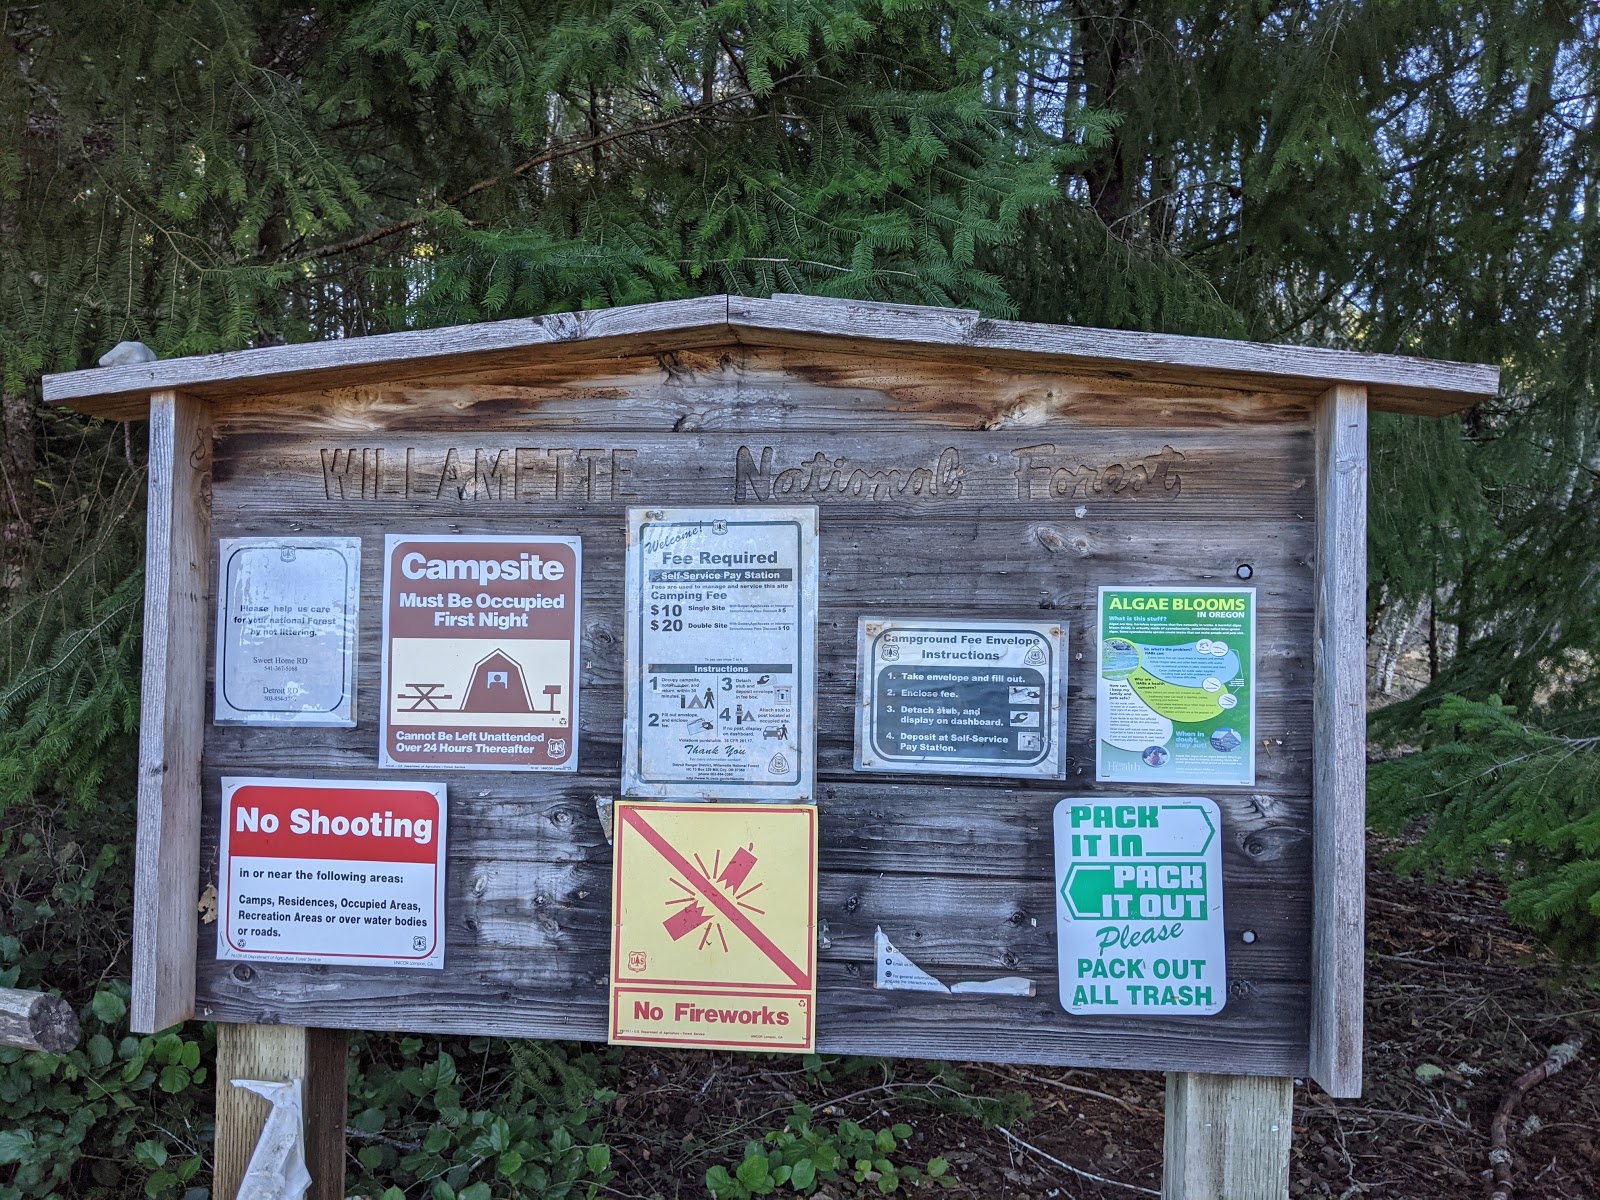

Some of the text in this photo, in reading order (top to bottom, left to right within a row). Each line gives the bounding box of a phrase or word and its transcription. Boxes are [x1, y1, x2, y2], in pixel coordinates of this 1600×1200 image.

[320, 444, 1185, 501] WILLAMETTE National Forest
[644, 521, 703, 554] Welcome!
[662, 551, 778, 566] Fee Required
[401, 552, 565, 586] Campsite
[661, 572, 719, 580] Self-Service
[723, 572, 742, 581] Pay
[400, 593, 565, 611] Must Be Occupied
[651, 591, 727, 602] Camping Fee
[240, 604, 268, 612] Please
[274, 605, 292, 613] help
[688, 605, 710, 613] Single
[1109, 597, 1245, 611] ALGAE BLOOMS
[234, 616, 246, 624] for
[248, 617, 267, 625] your
[307, 617, 336, 625] Forest
[434, 612, 528, 630] First Night
[280, 628, 317, 637] littering.
[883, 634, 1040, 647] Campground Fee Envelope
[253, 656, 273, 664] Sweet
[922, 650, 1000, 661] Instructions
[694, 665, 749, 673] Instructions
[649, 676, 659, 691] 1
[721, 676, 733, 691] 3
[901, 673, 924, 681] Take
[927, 674, 969, 684] envelope
[992, 675, 1004, 683] fill
[263, 686, 285, 694] Detroit
[887, 689, 959, 698] 2. Enclose fee.
[719, 707, 731, 721] 4
[901, 706, 934, 714] Detach
[936, 707, 960, 716] stub,
[962, 708, 980, 716] and
[648, 713, 659, 727] 2
[900, 716, 934, 725] display
[950, 717, 1004, 726] dashboard.
[396, 730, 545, 742] Cannot Be Left Unattended
[886, 732, 895, 740] 4.
[900, 733, 936, 742] Deposit
[950, 734, 1008, 744] Self-Service
[396, 743, 534, 754] Over 24 Hours Thereafter
[684, 744, 746, 757] Thank You
[900, 743, 957, 752] Pay Station.
[1071, 805, 1159, 828] PACK
[236, 806, 433, 845] No Shooting
[1072, 834, 1142, 856] IT IN
[239, 868, 404, 884] in or near the following areas:
[1114, 865, 1203, 889] PACK
[239, 894, 421, 913] Camps, Residences, Occupied Areas,
[1102, 894, 1205, 918] IT OUT
[238, 910, 428, 927] Recreation Areas or over water bodies
[237, 927, 281, 938] or roads.
[1095, 922, 1184, 956] Please
[1077, 958, 1206, 980] PACK OUT
[1072, 985, 1212, 1007] ALL TRASH
[634, 1001, 790, 1026] No Fireworks
